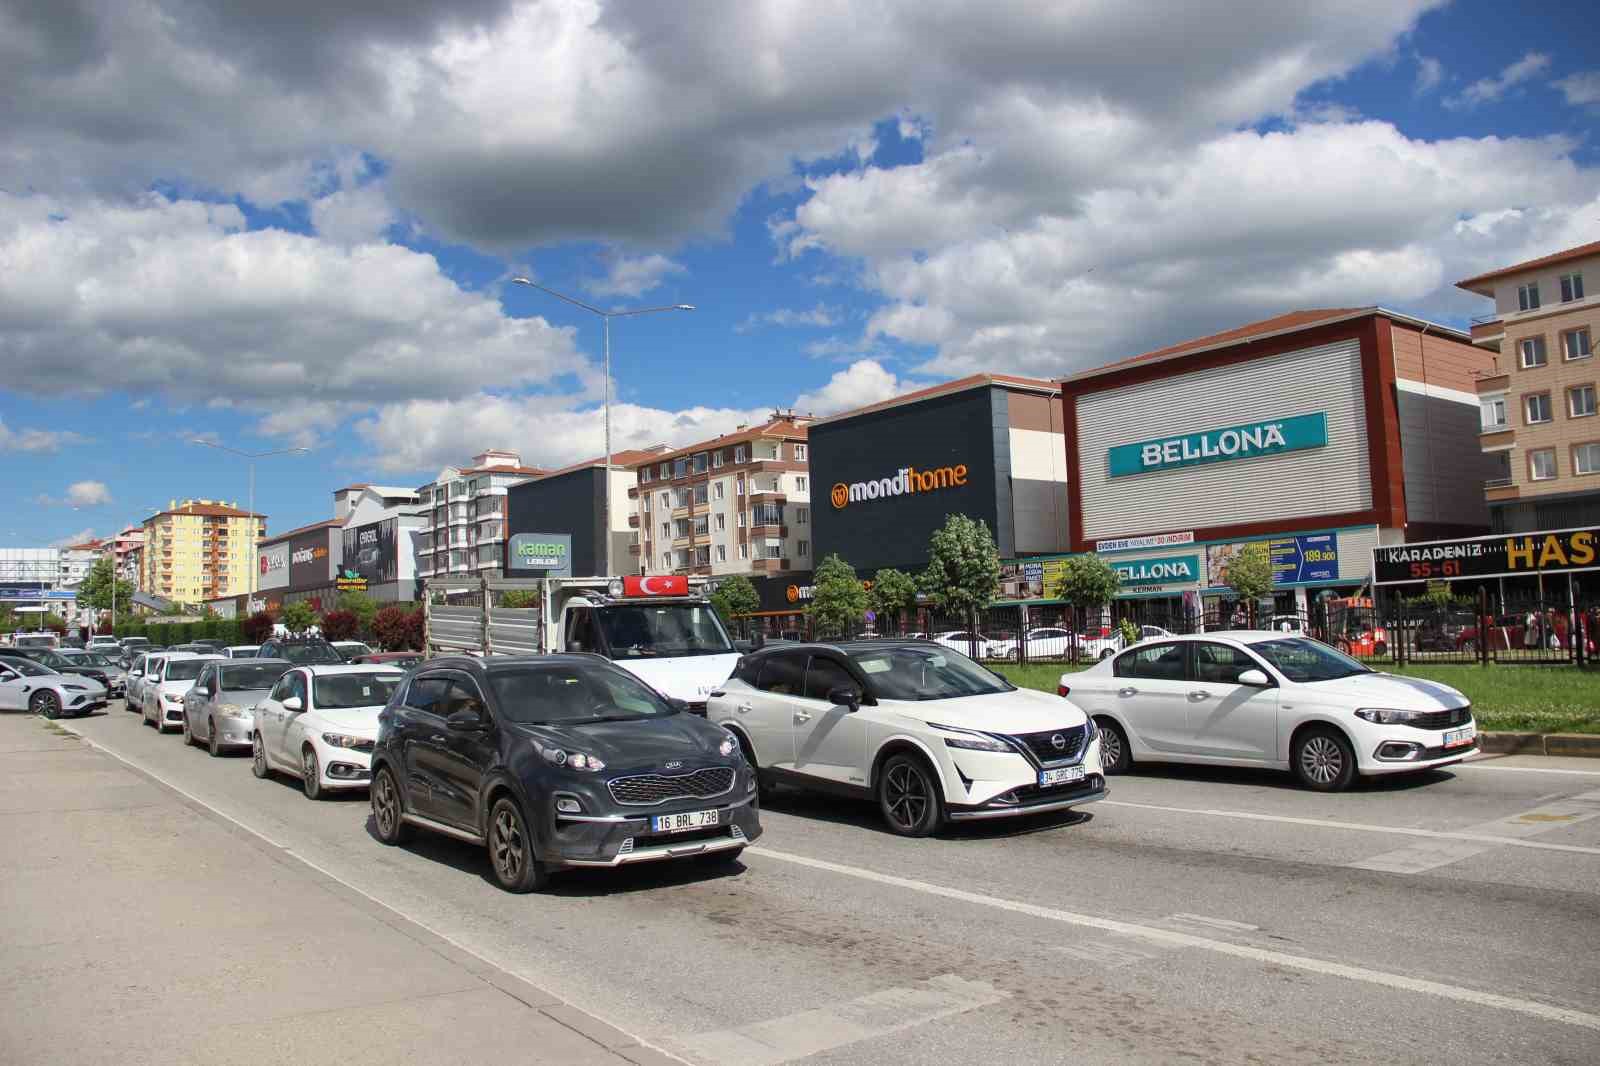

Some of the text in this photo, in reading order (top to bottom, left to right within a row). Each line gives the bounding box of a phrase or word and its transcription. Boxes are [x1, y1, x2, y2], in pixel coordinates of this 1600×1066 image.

[1141, 423, 1286, 466] BELLONA
[517, 541, 567, 556] kaman
[1506, 531, 1596, 569] HAS
[1113, 561, 1191, 582] ELLONA
[660, 811, 717, 831] 16 BRL 738
